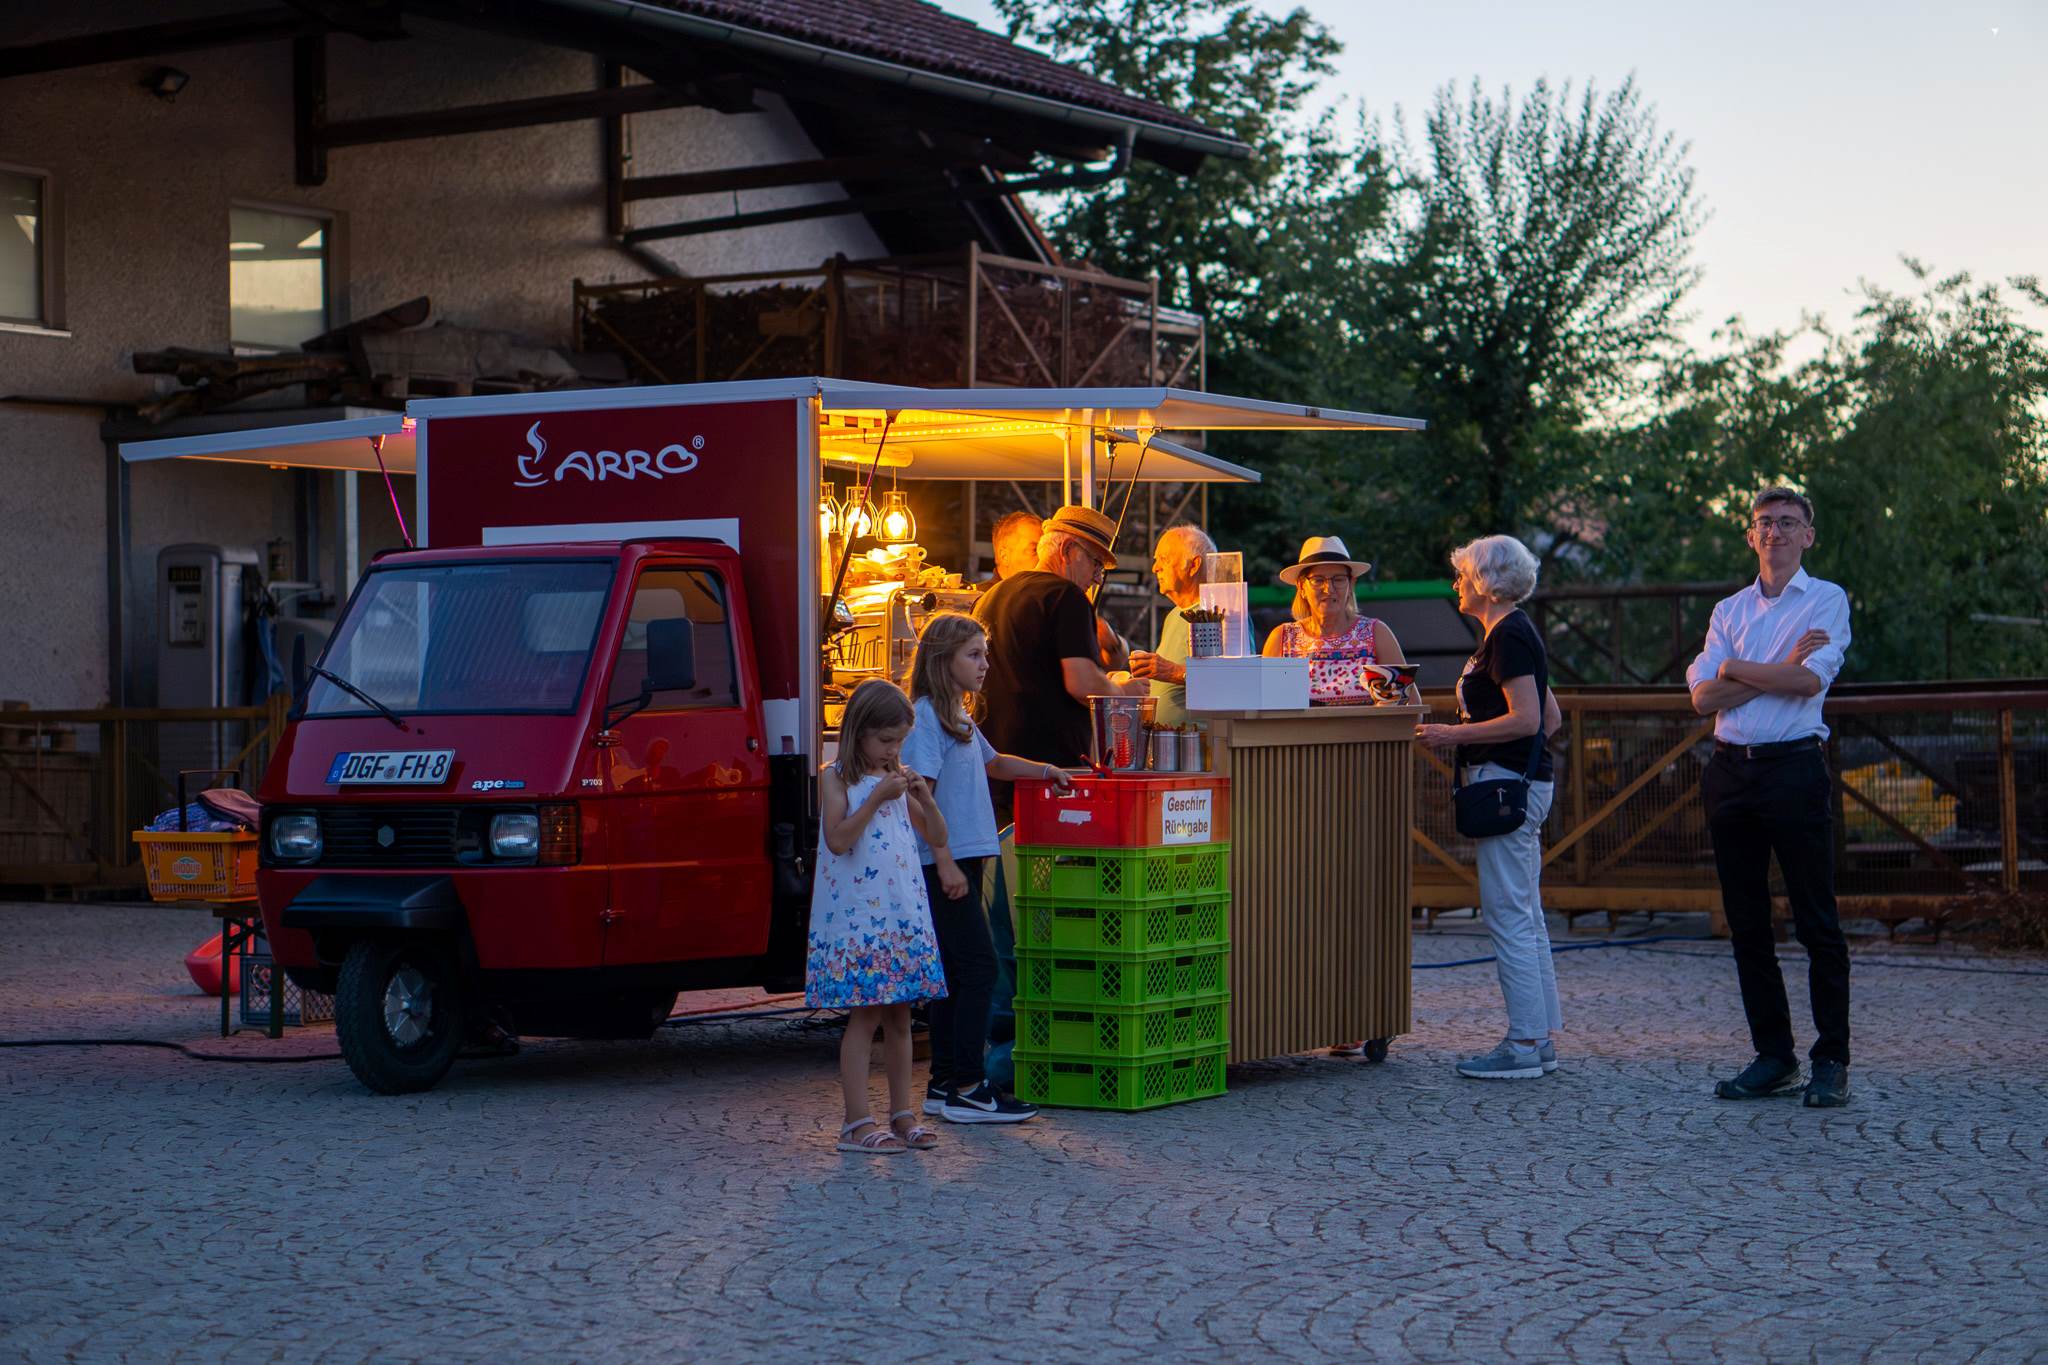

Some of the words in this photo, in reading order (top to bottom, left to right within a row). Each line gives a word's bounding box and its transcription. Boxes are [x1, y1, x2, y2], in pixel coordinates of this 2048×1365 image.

[342, 755, 390, 779] DGF
[472, 780, 504, 791] ape
[1167, 796, 1207, 812] Geschirr
[1165, 819, 1208, 837] Rückgabe
